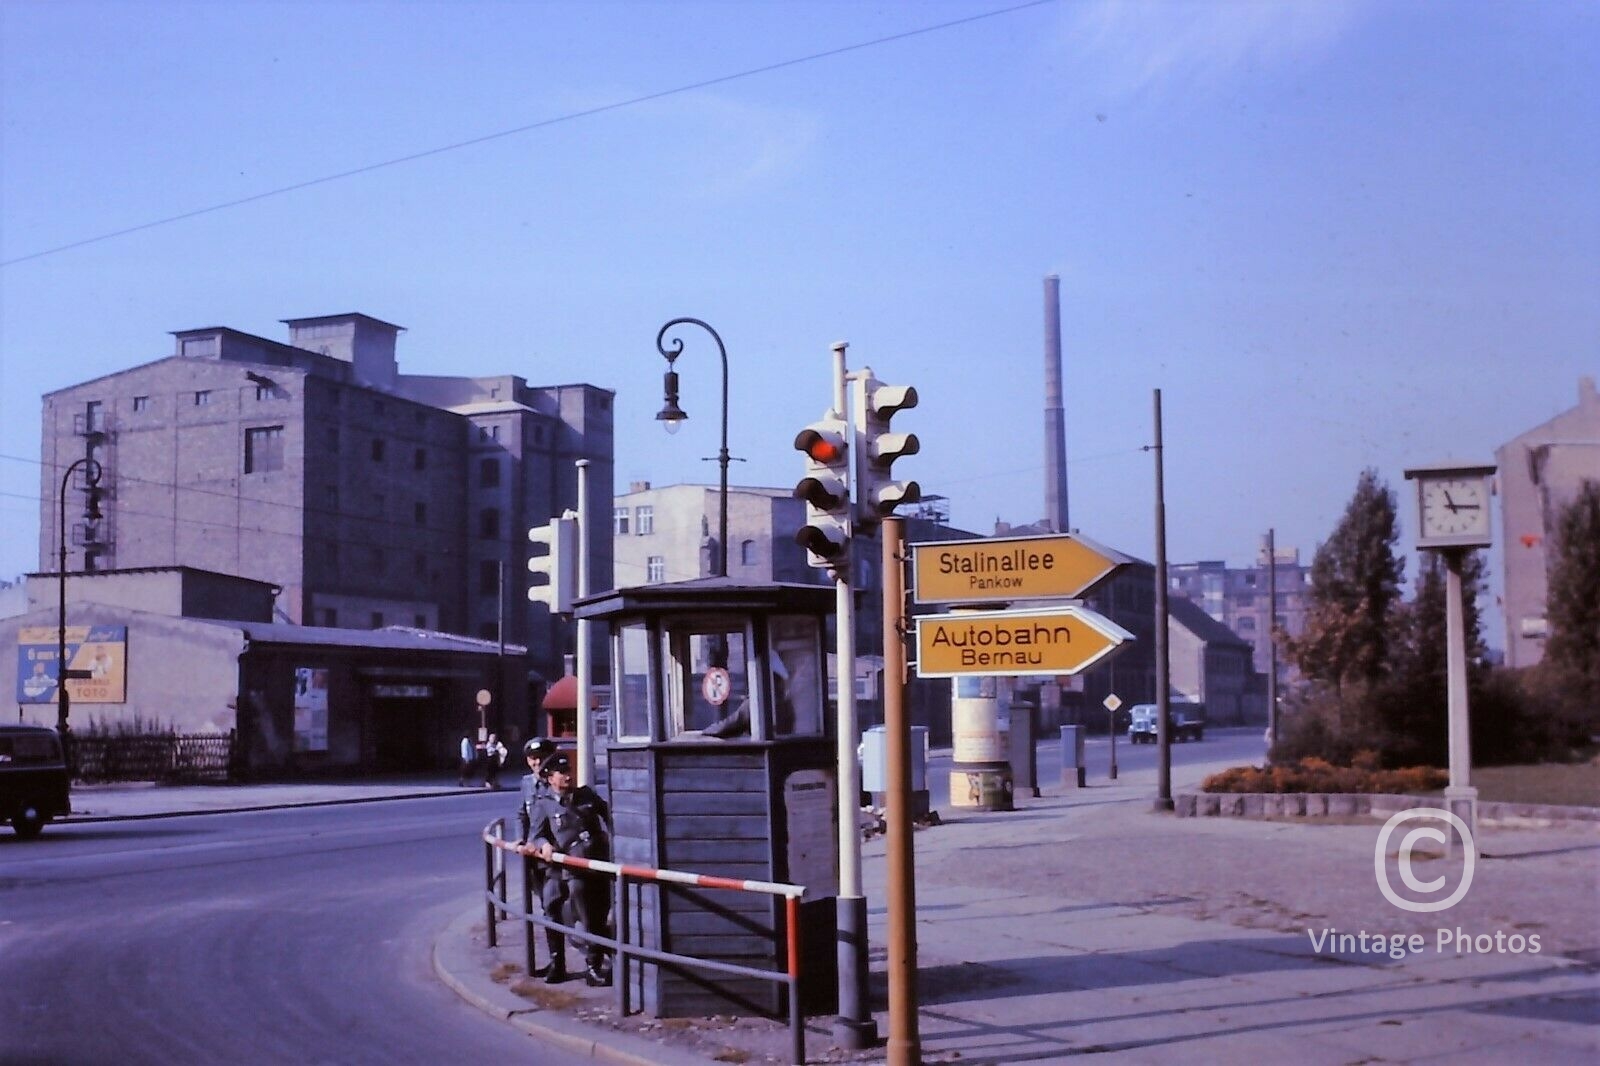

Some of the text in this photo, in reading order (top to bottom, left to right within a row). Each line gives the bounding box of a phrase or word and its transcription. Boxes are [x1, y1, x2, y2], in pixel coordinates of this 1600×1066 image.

[940, 550, 1054, 574] Stalinallee
[970, 577, 1024, 589] Pankow
[932, 624, 1071, 647] Autobahn
[961, 649, 1042, 666] Bernau
